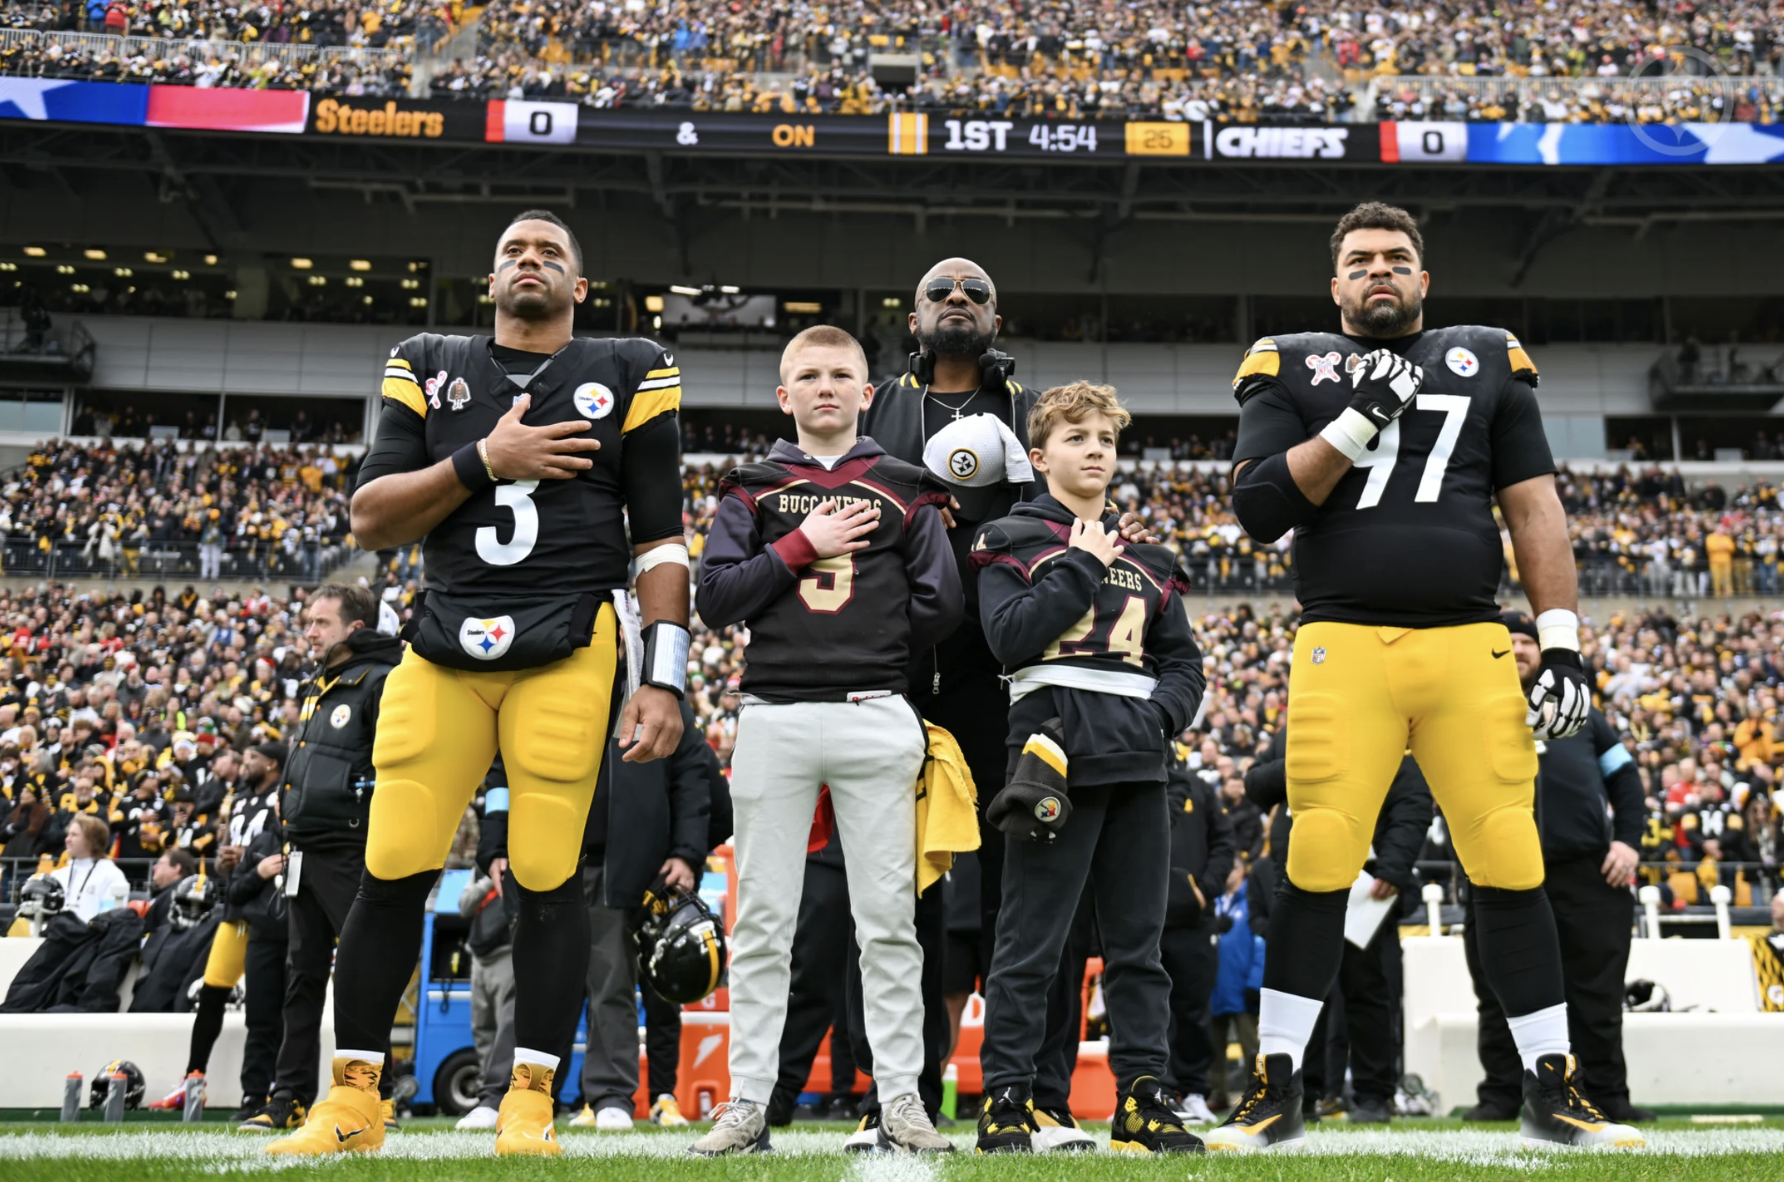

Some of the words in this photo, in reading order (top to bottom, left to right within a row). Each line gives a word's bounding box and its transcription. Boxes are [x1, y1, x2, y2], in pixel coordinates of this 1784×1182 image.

[315, 98, 443, 137] Steelers
[529, 110, 553, 136] 0
[676, 122, 698, 146] &
[772, 124, 814, 147] ON
[945, 120, 1013, 151] 1ST
[1029, 123, 1097, 152] 4:54
[1143, 129, 1173, 150] 25
[1216, 127, 1348, 158] CHIEFS
[1422, 131, 1444, 155] 0
[475, 479, 539, 566] 3
